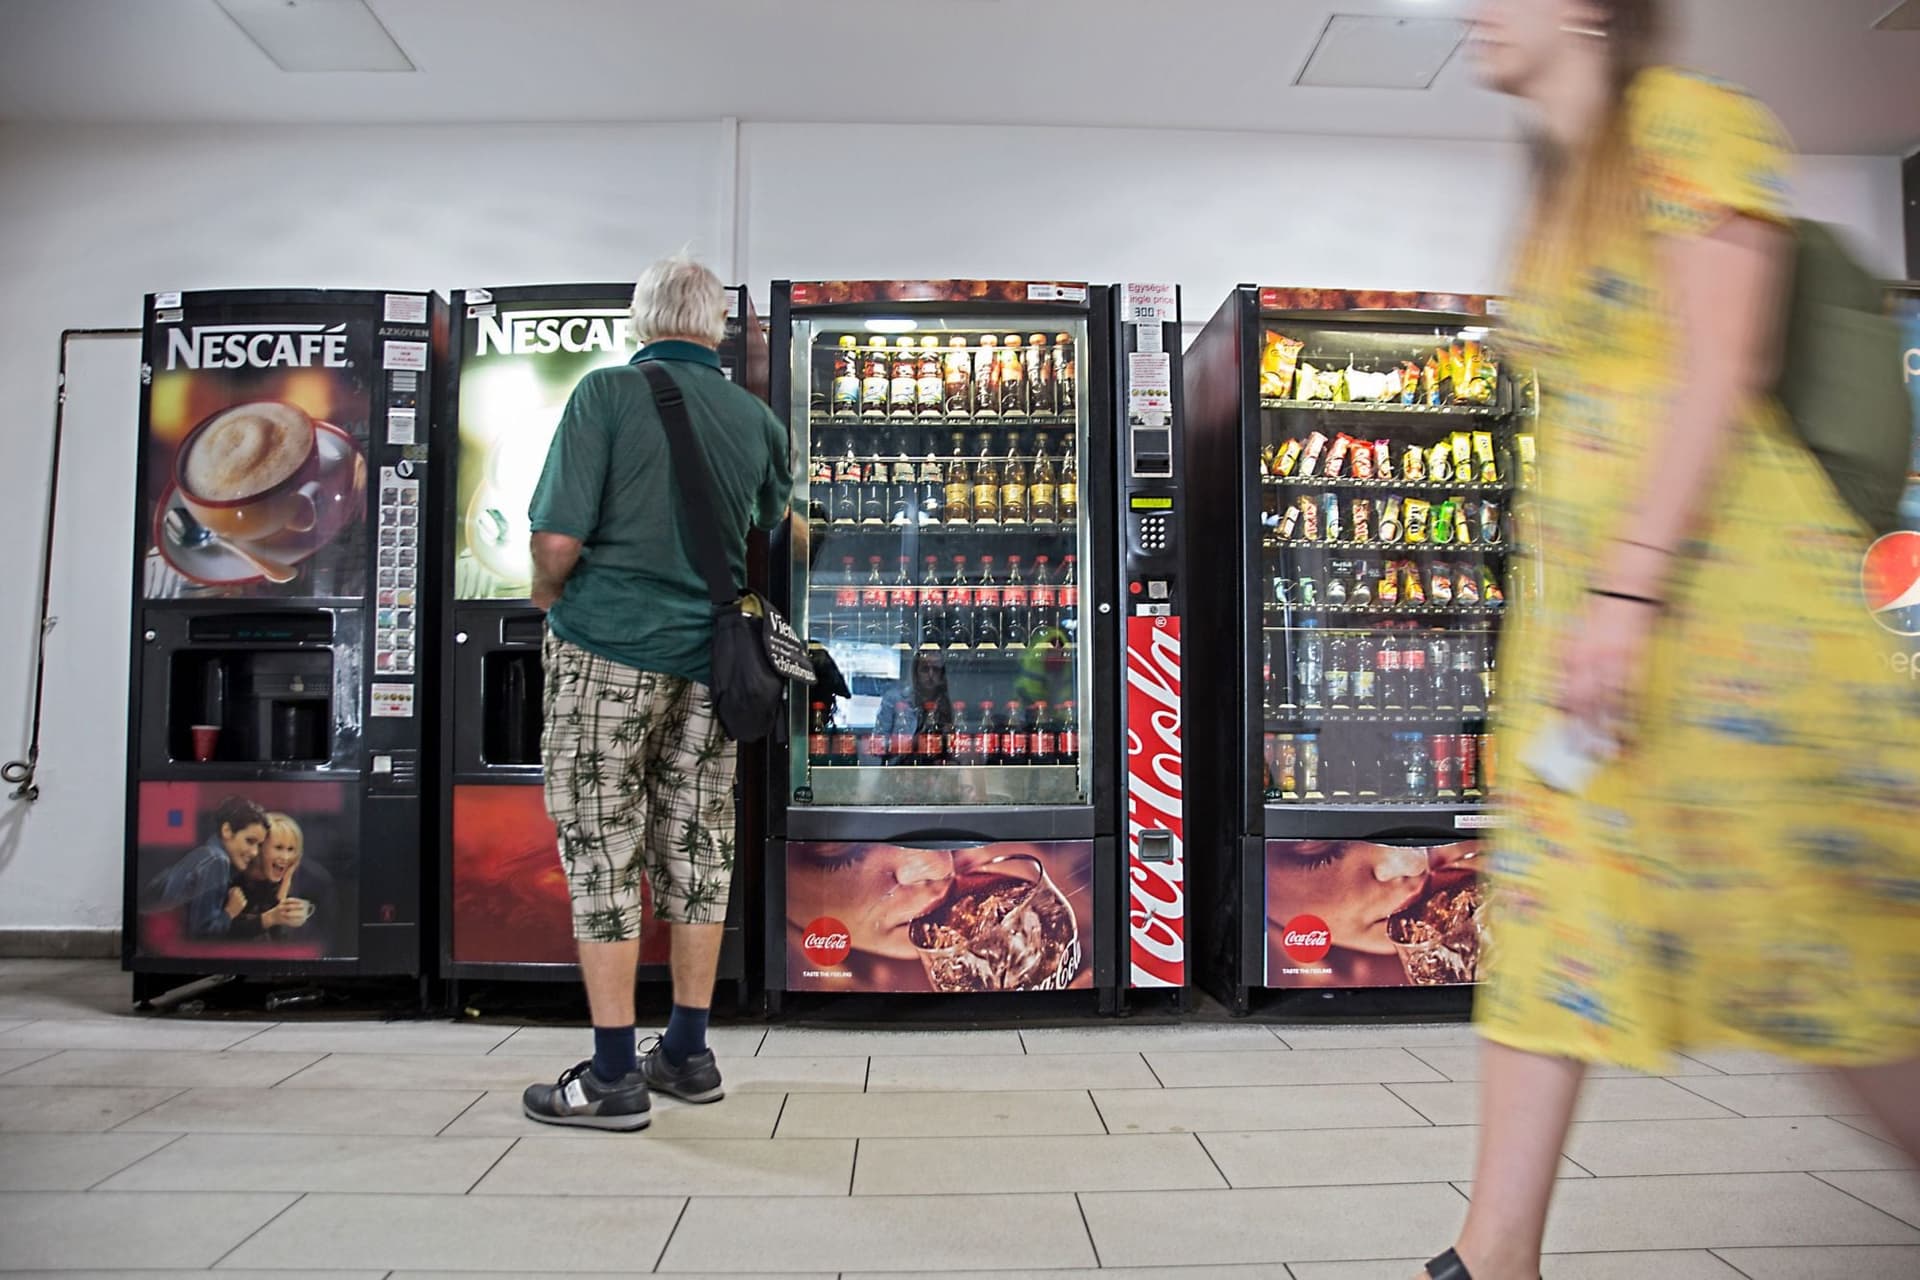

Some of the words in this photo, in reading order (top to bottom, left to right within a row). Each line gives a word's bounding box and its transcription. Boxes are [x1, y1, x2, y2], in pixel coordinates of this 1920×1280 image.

[1135, 307, 1154, 317] 300
[166, 322, 350, 370] NESCAFÉ
[378, 327, 430, 337] AZKOYEN
[475, 309, 644, 355] NESCAF
